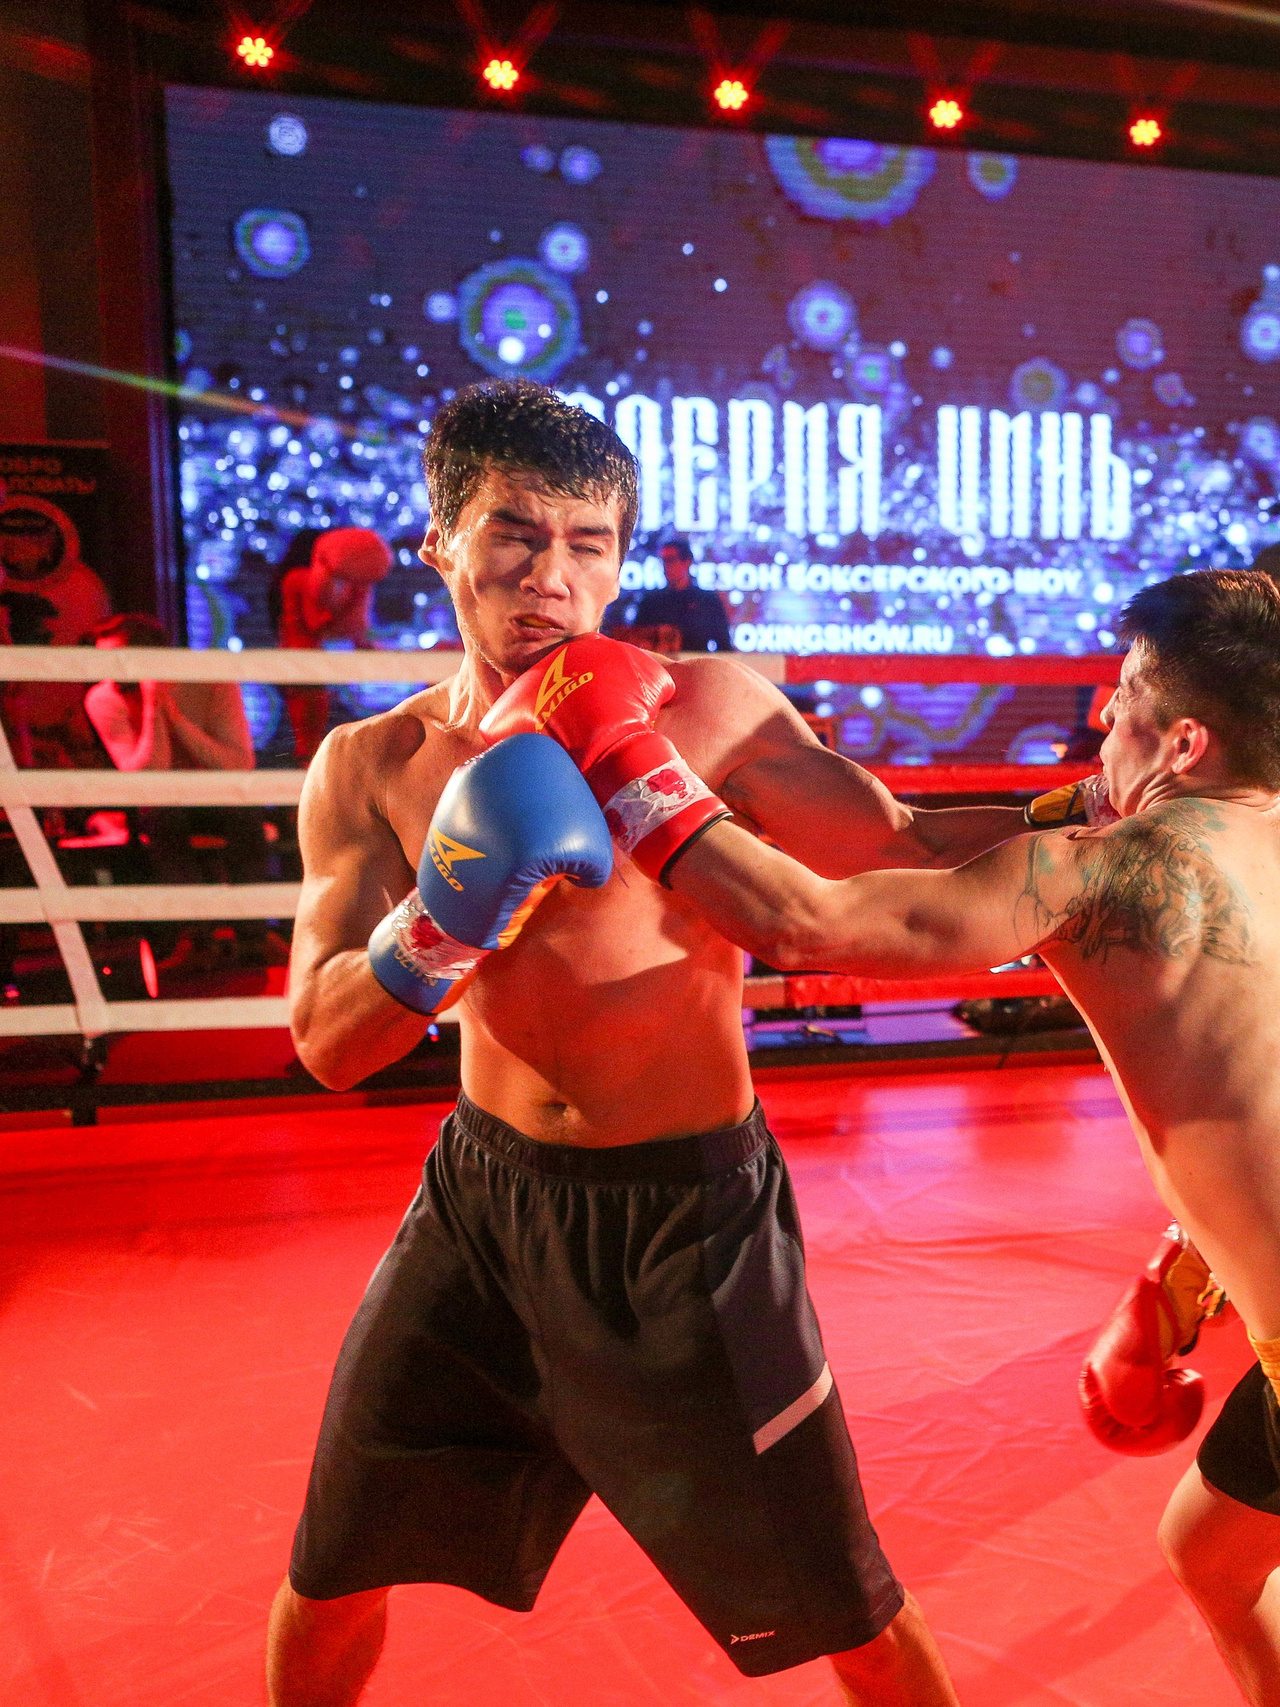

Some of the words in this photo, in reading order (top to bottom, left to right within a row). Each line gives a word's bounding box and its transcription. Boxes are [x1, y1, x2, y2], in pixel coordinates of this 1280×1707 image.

[0, 457, 62, 475] ОБРО
[556, 391, 883, 536] ПЕРИЯ
[937, 404, 1132, 546] ЦИНЬ
[690, 562, 781, 592] ЕЗОН
[786, 563, 1012, 595] БОКСЕРСКОГО
[1013, 566, 1083, 596] ШОУ
[734, 621, 954, 653] OXINGSHOW.RU
[740, 1630, 776, 1642] DEMIX
